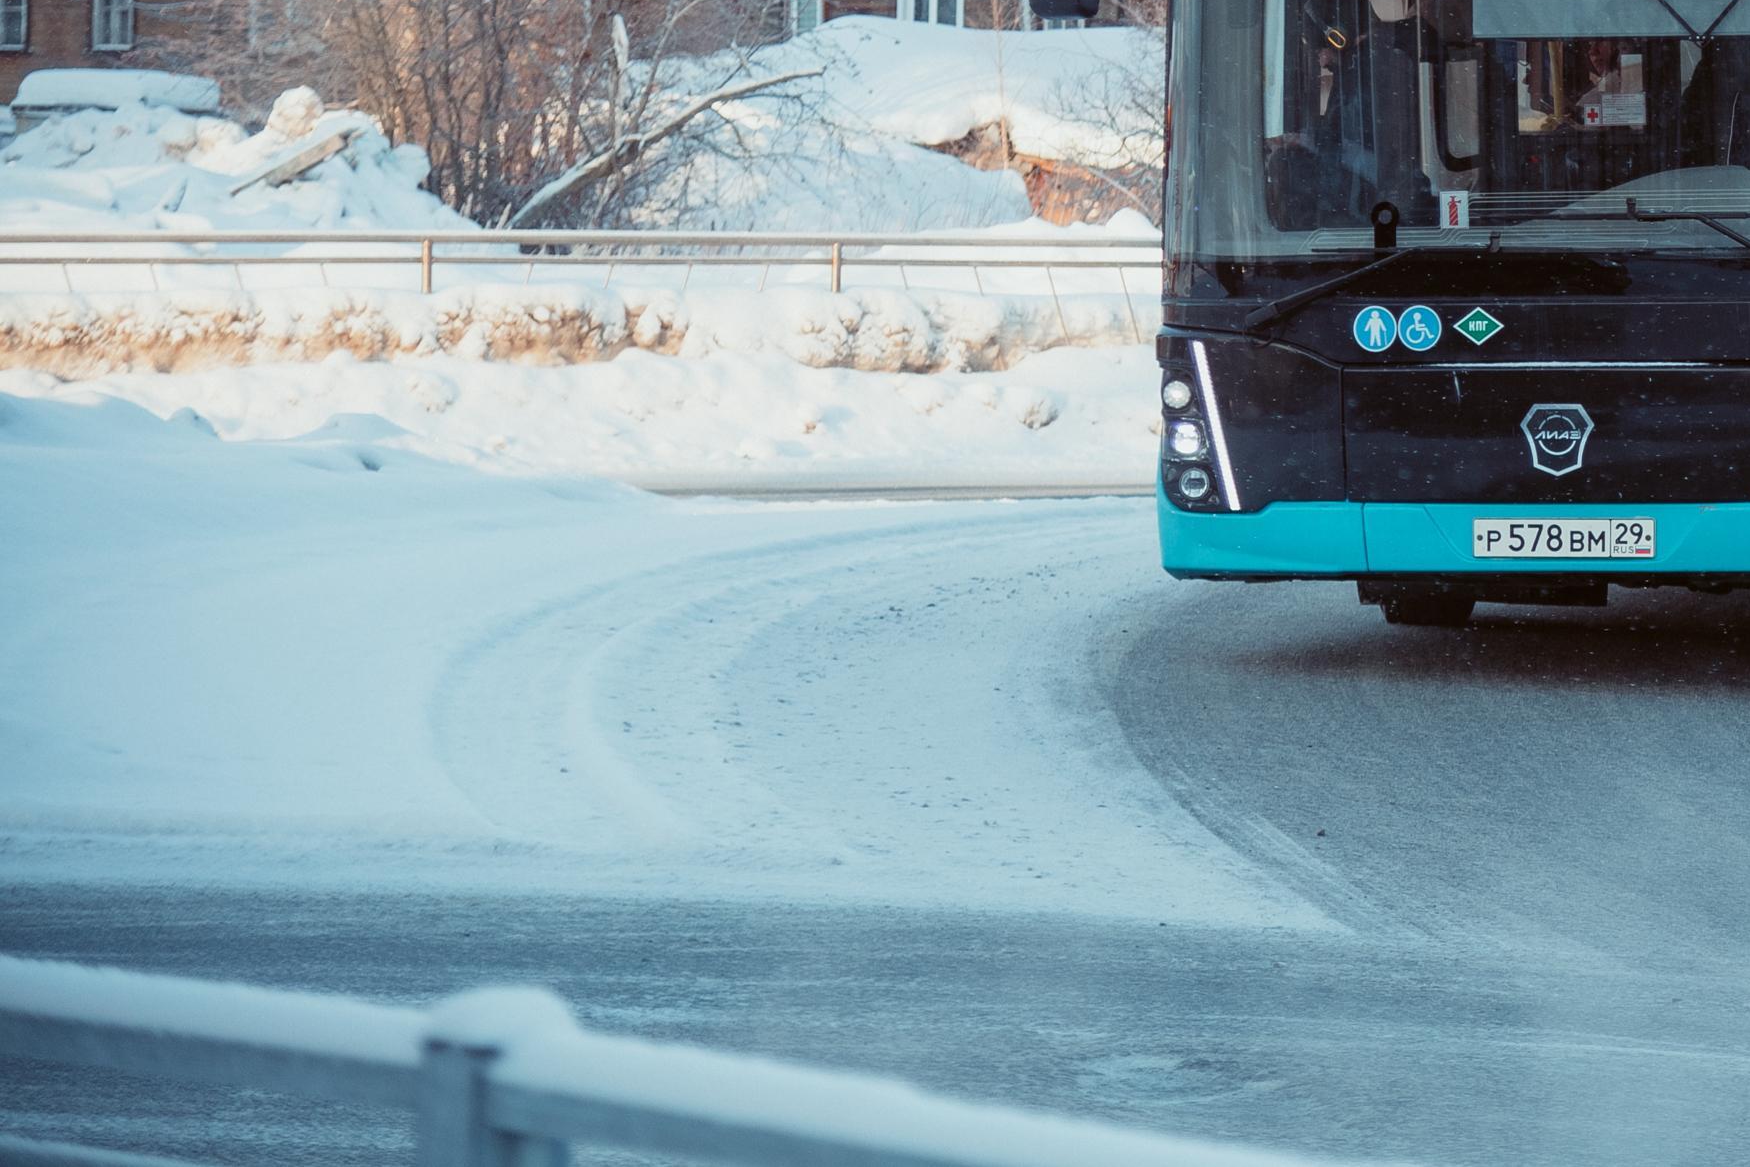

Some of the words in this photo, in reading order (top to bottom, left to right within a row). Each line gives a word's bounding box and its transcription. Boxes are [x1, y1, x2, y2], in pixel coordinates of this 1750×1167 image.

[1468, 320, 1489, 332] КПГ
[1615, 522, 1644, 545] 29
[1613, 545, 1634, 554] RUS
